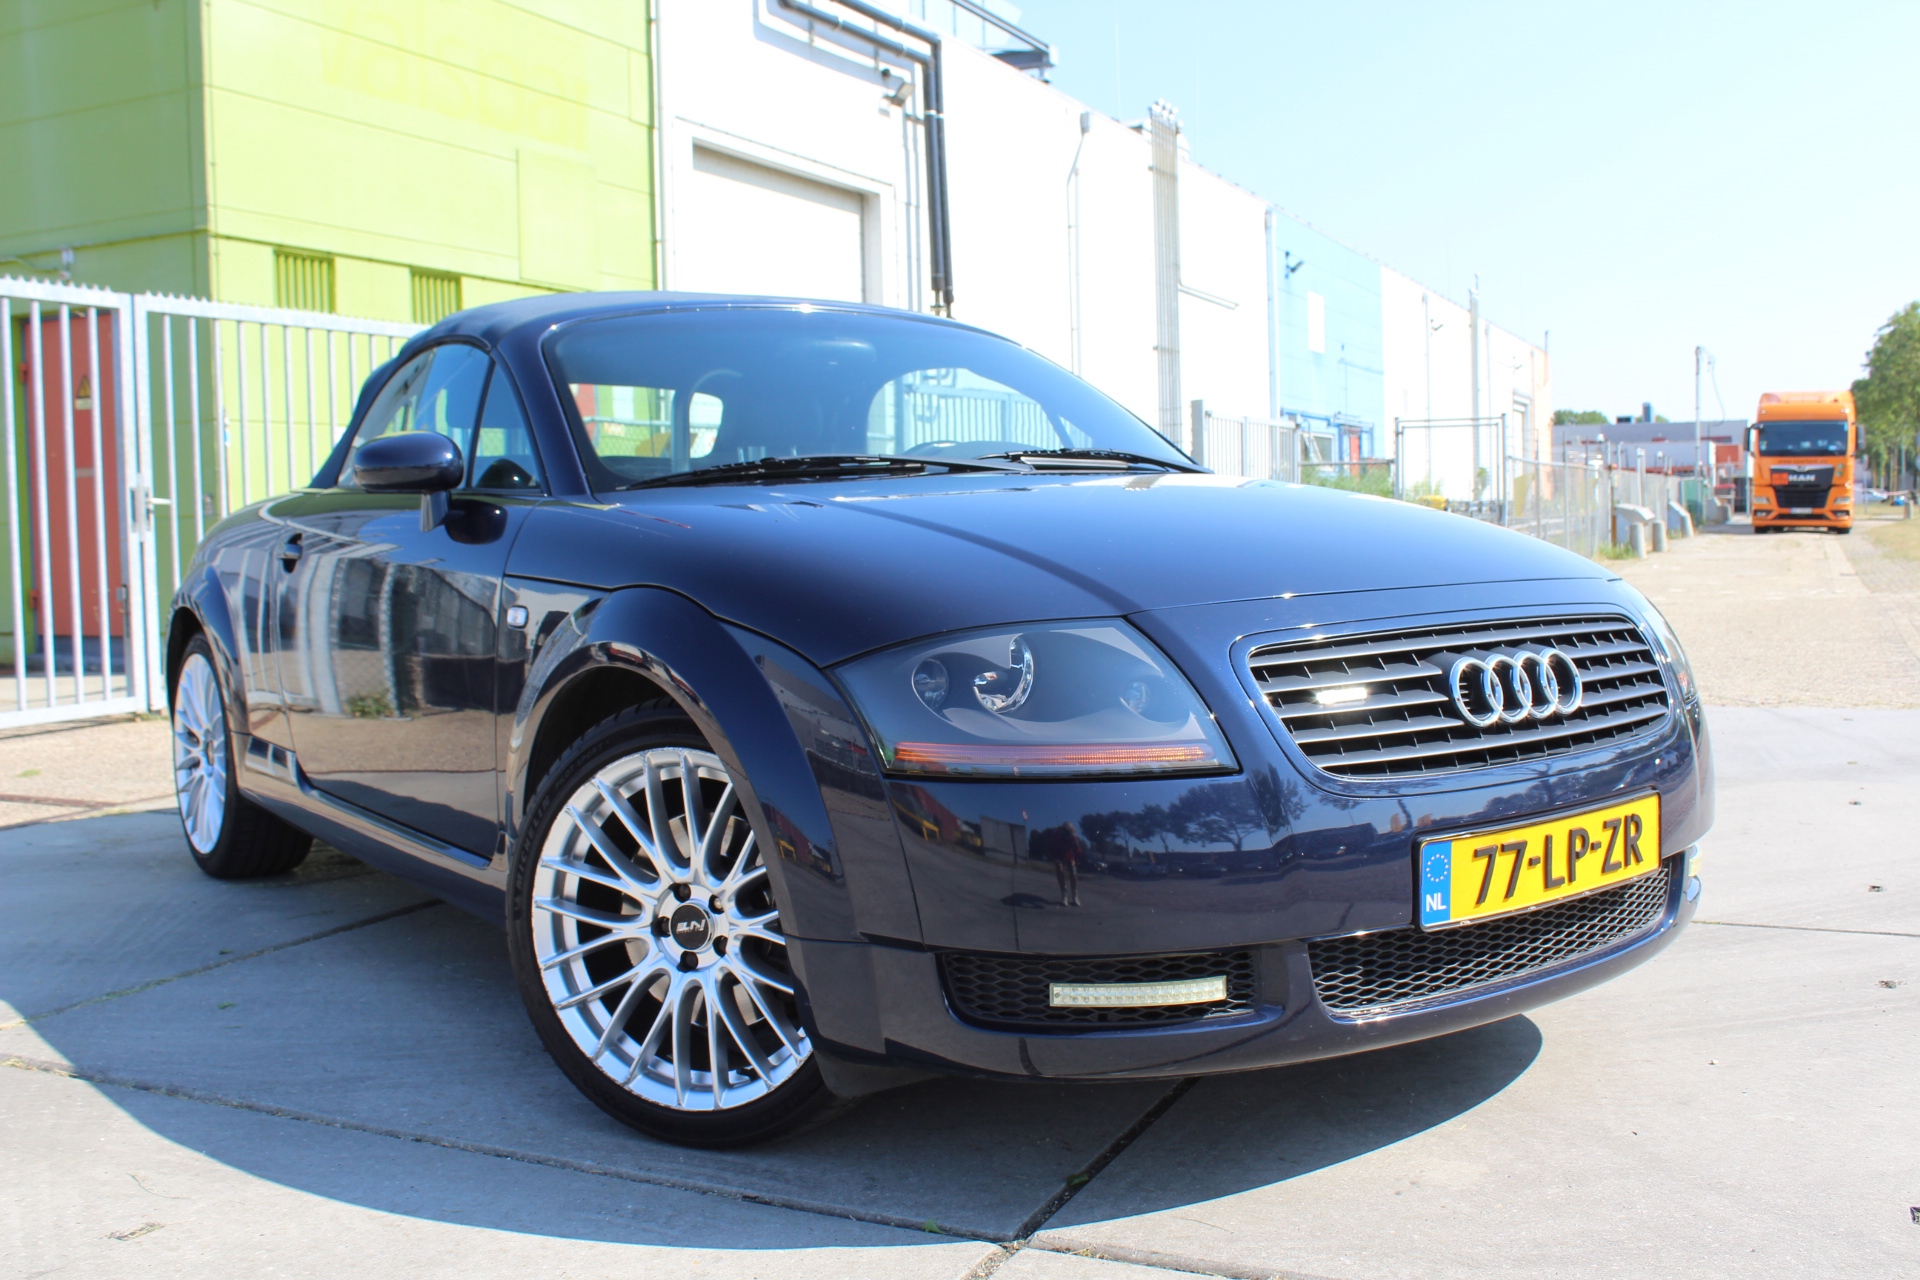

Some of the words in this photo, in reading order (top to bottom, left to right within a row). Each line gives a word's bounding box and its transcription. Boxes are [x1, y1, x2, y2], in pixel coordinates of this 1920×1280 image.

[516, 795, 550, 890] MICHELIN
[1474, 814, 1643, 906] 77-LP-ZR
[1425, 892, 1447, 913] NL
